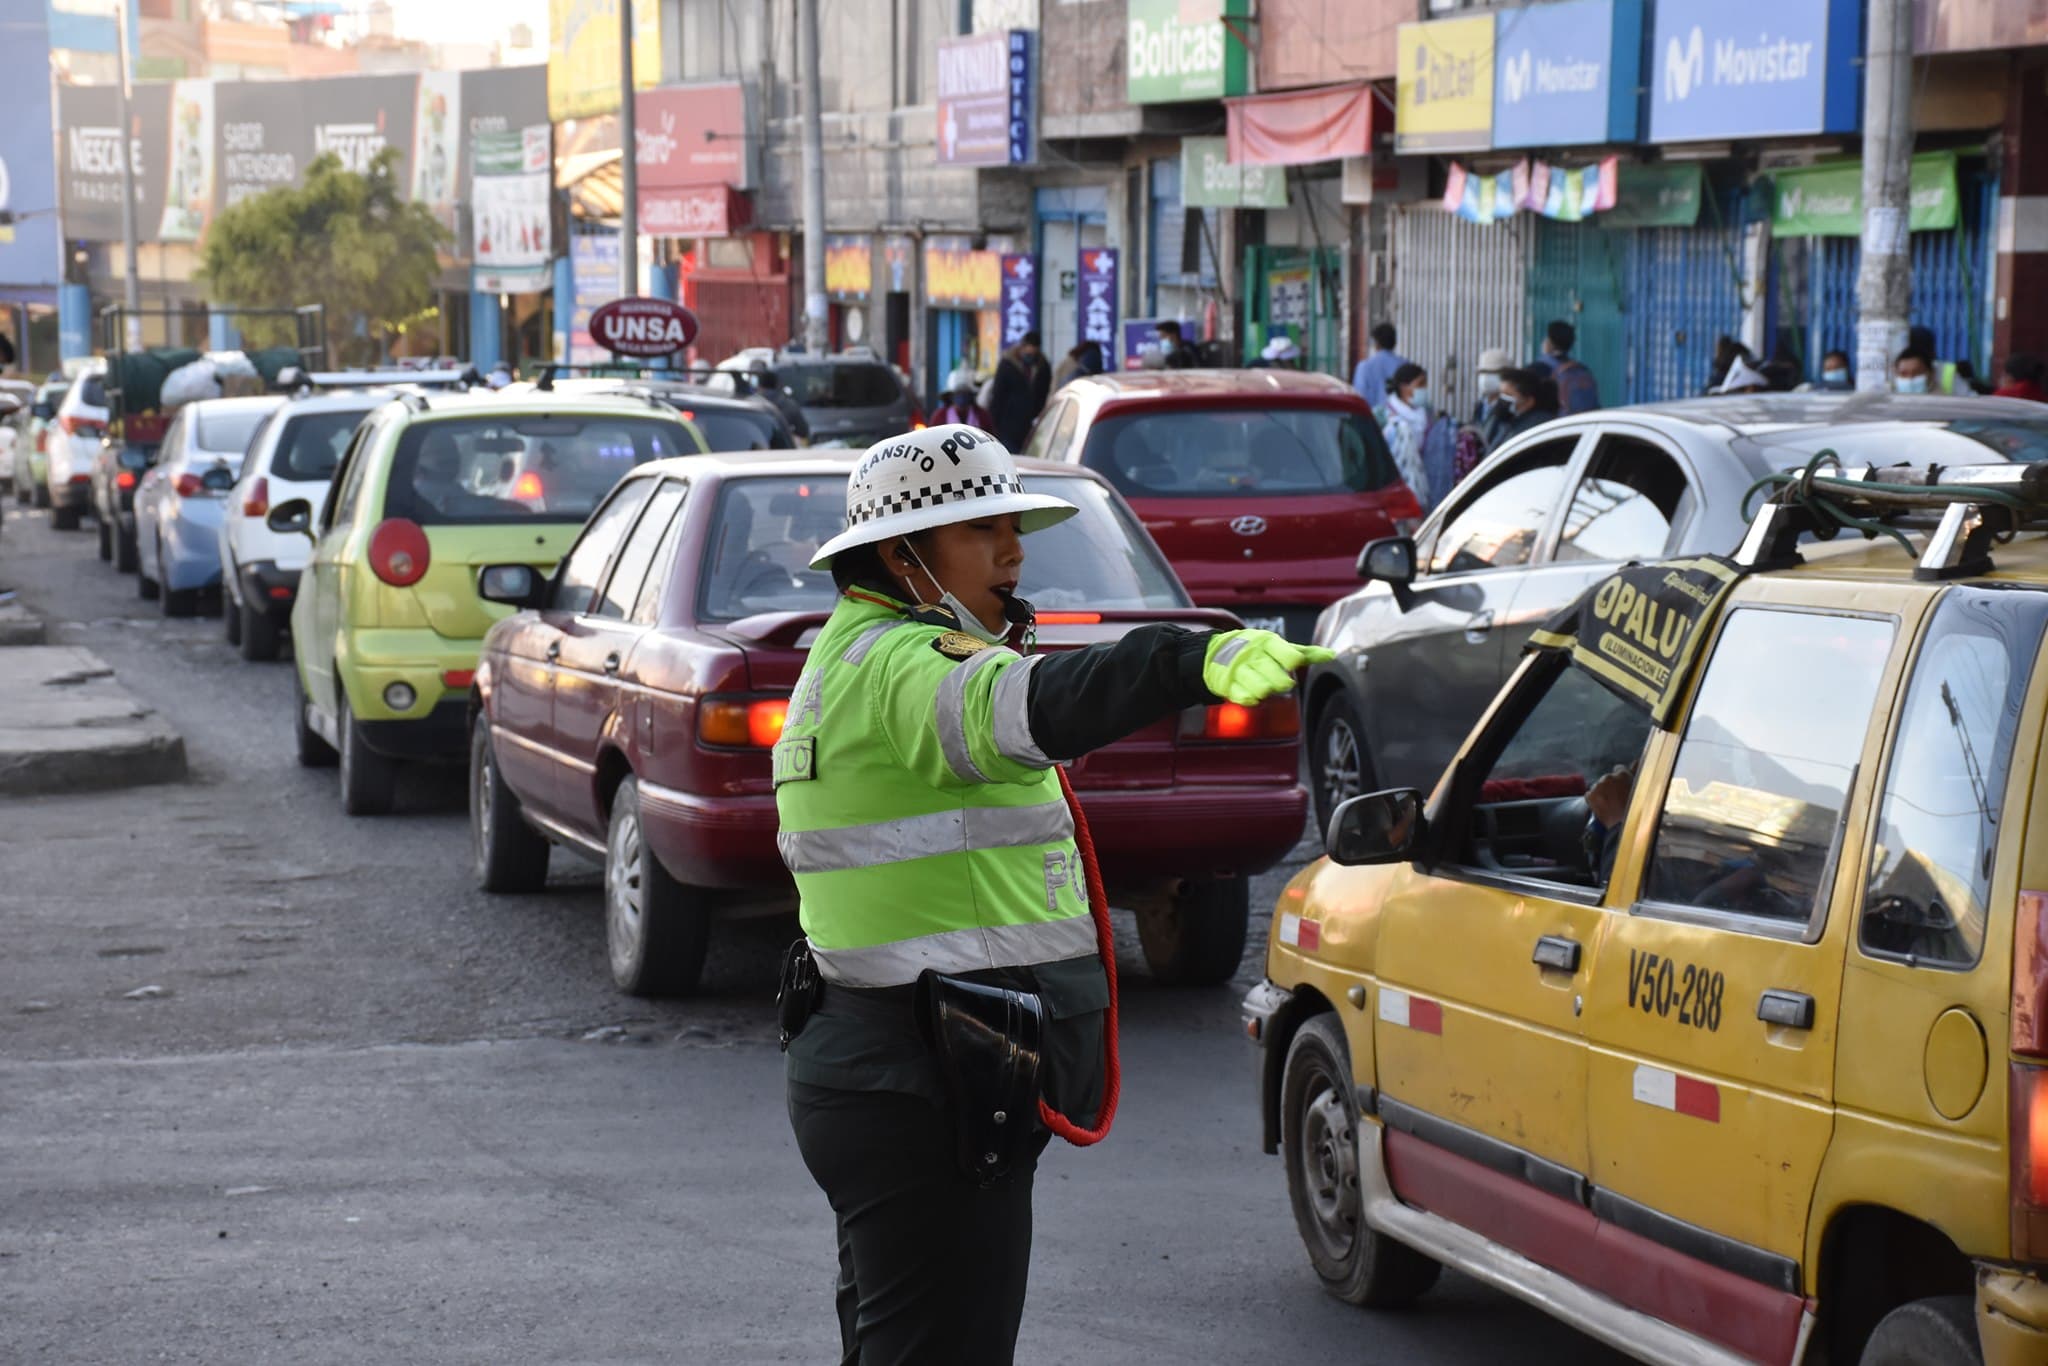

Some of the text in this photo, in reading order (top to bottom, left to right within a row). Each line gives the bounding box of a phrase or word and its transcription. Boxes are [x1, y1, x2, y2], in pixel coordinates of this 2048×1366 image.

[1129, 17, 1224, 79] Boticas
[1535, 57, 1600, 93] Movistar
[1713, 33, 1813, 85] Movistar
[1010, 33, 1025, 161] BOTICA
[604, 315, 685, 343] UNSA
[855, 428, 998, 483] RANSITO POL
[1593, 575, 1692, 659] OPALU
[1603, 637, 1656, 678] ILUMINACION
[1627, 947, 1726, 1034] V50-288
